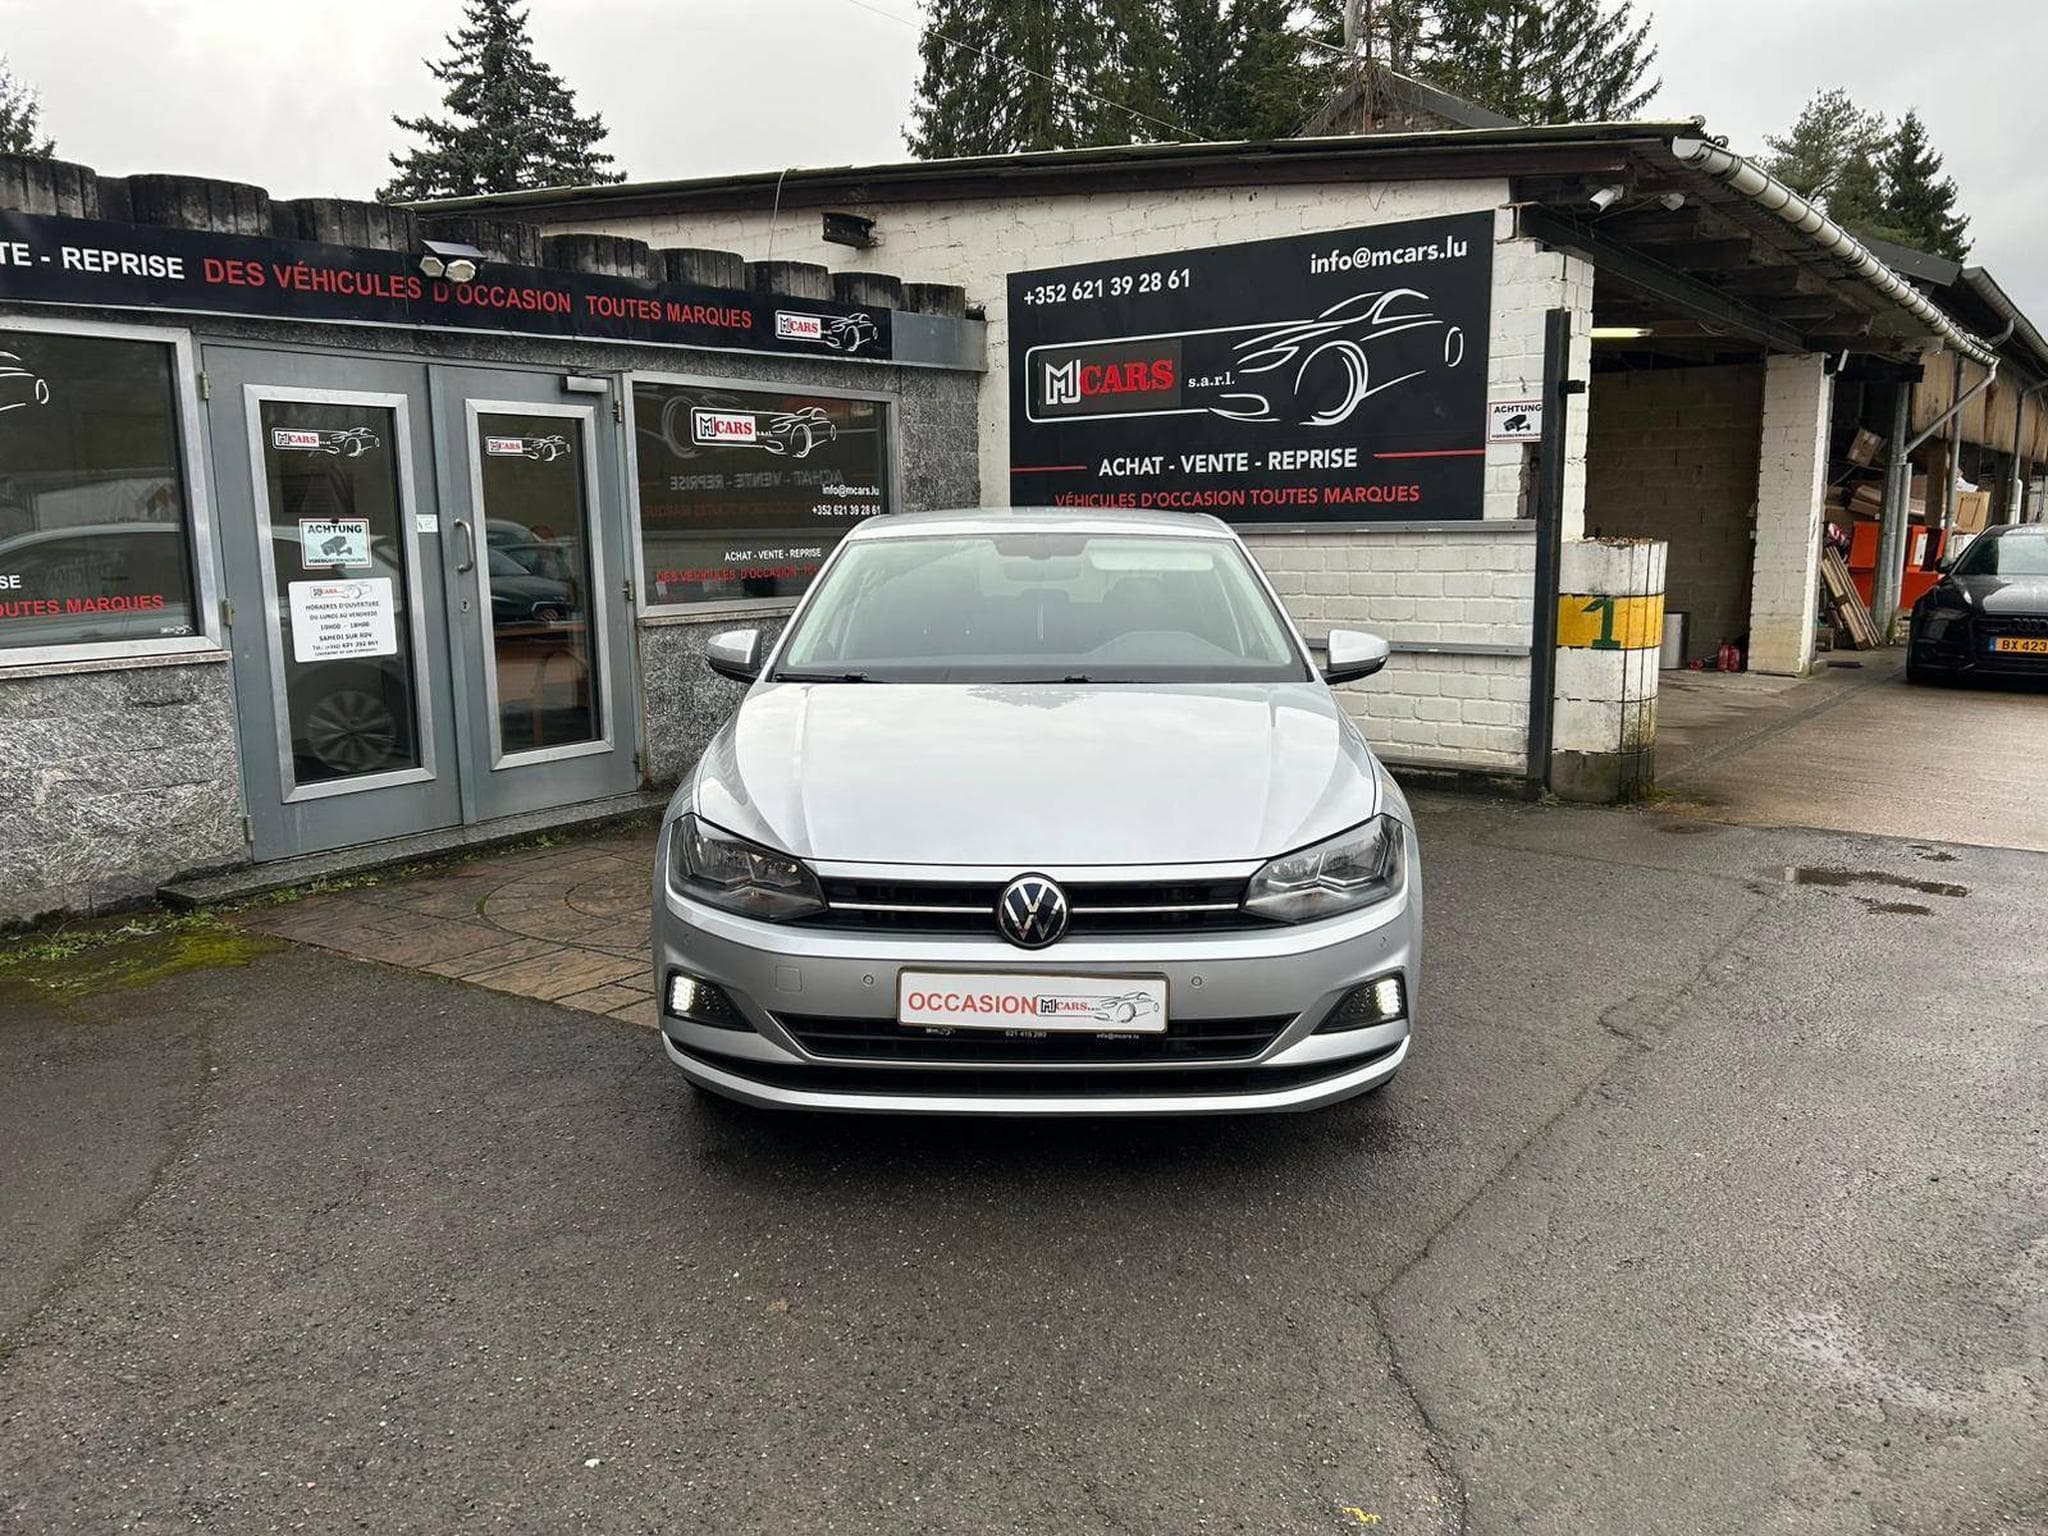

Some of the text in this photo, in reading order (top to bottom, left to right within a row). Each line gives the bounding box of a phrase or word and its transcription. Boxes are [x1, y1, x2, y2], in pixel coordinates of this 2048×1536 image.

[1311, 235, 1467, 274] info@mcars.lu
[61, 246, 185, 279] REPRISE
[204, 258, 265, 287] DES
[272, 261, 422, 299] VÉHICULES
[586, 295, 661, 320] TOUTES
[667, 303, 752, 328] MARQUES
[1024, 268, 1191, 305] +352 621 39 28 61
[1080, 360, 1176, 396] CARS
[1188, 372, 1235, 388] s.a.r.l.
[1494, 404, 1542, 414] ACHTUNG
[1098, 456, 1164, 477] ACHAT
[1180, 453, 1248, 474] VENTE
[1268, 448, 1357, 470] REPRISE
[1056, 485, 1420, 508] VÉHICULES D'OCCASION TOUTES MARQUES
[812, 504, 832, 516] +352
[833, 504, 848, 516] 621
[850, 504, 859, 516] 39
[872, 504, 880, 515] 61
[308, 524, 362, 534] ACHTUNG
[724, 550, 750, 562] ACHAT
[759, 550, 784, 560] VENTE
[790, 548, 822, 558] REPRISE
[67, 594, 164, 614] MARQUES
[1582, 596, 1620, 650] 1
[2002, 640, 2018, 650] BX
[908, 992, 1037, 1014] OCCASION
